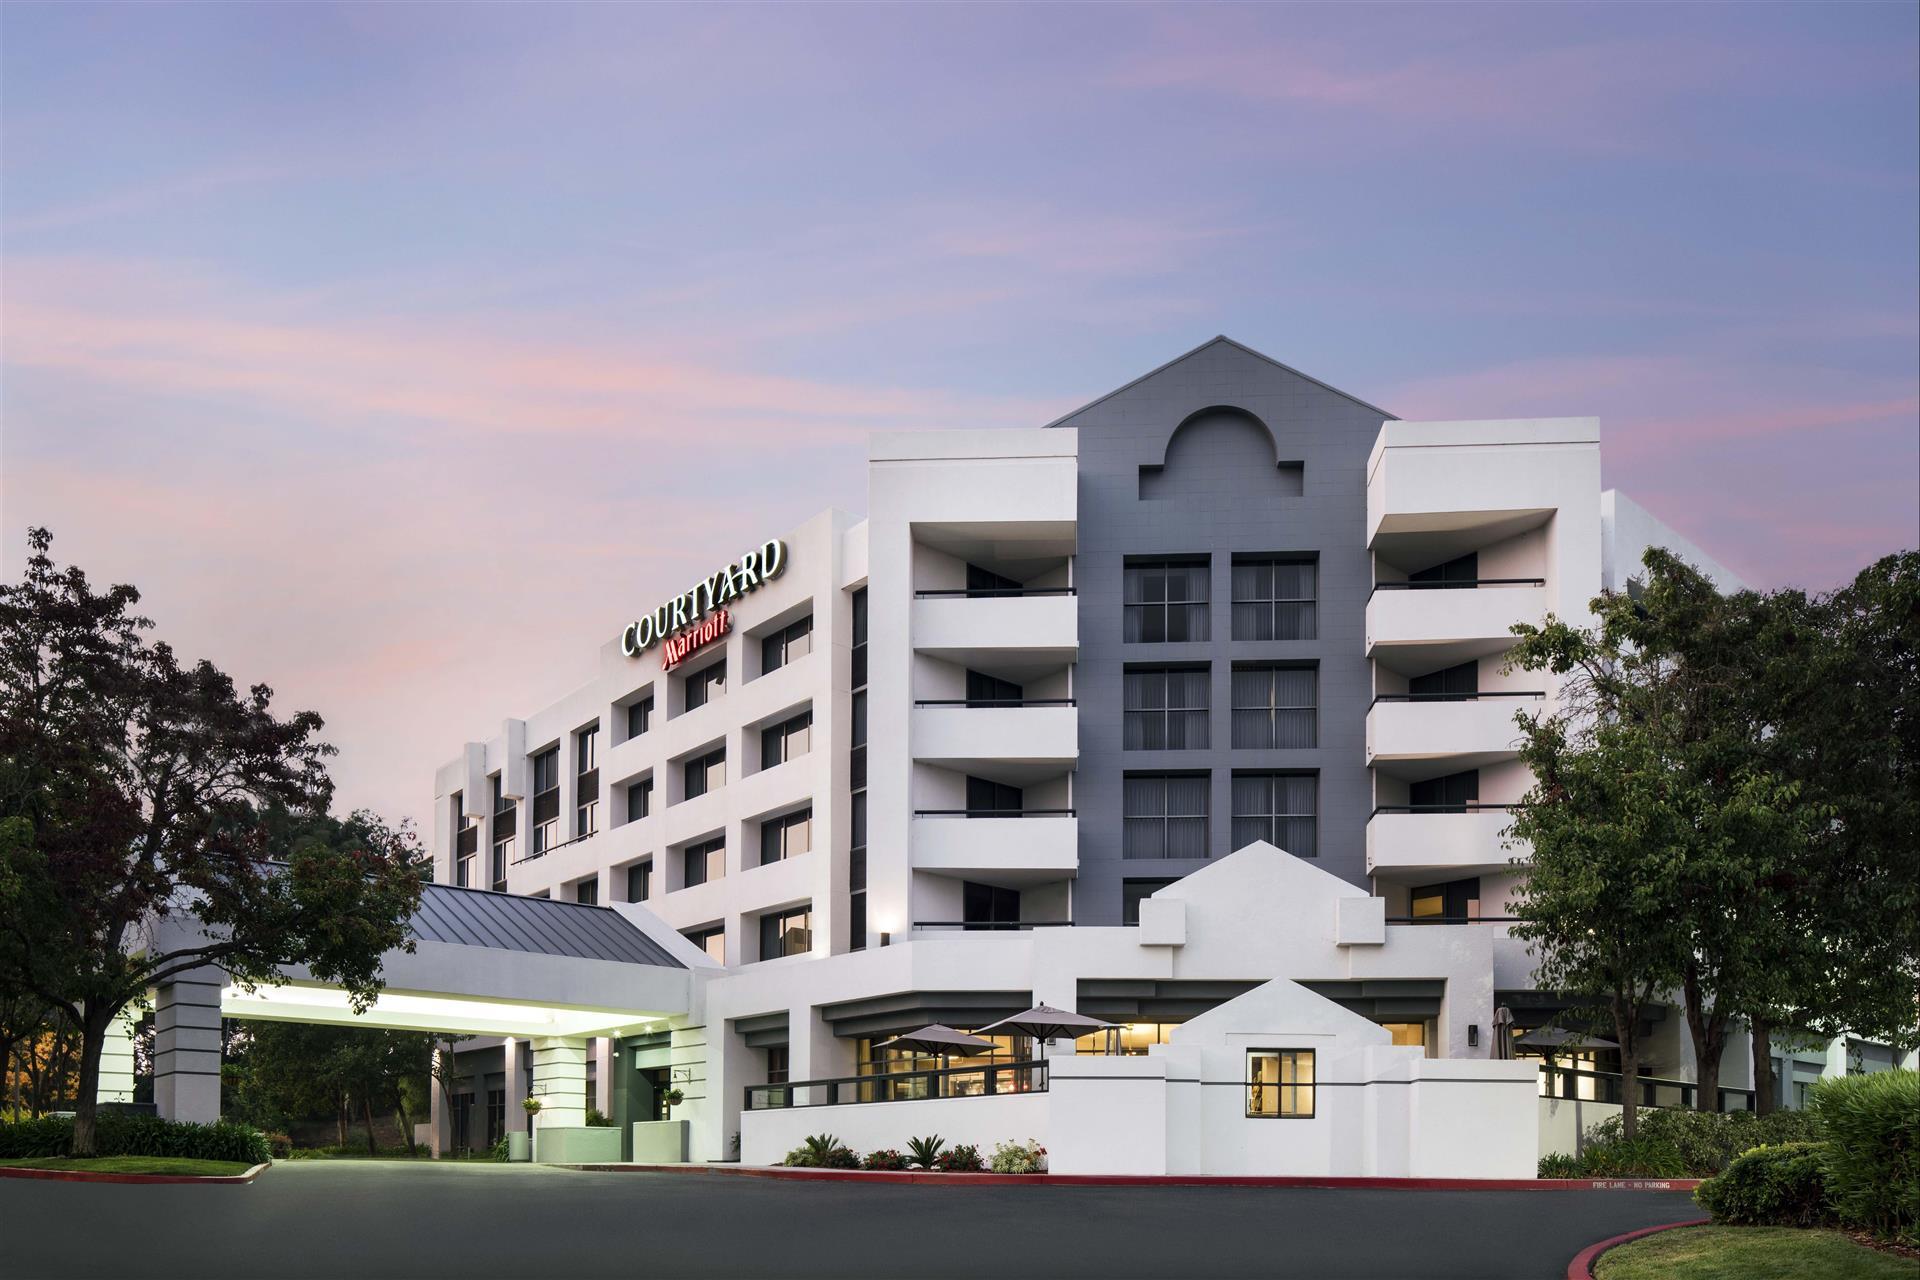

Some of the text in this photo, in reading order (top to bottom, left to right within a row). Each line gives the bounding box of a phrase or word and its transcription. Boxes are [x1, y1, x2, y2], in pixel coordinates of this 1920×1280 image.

[621, 538, 786, 658] COURTYARD
[662, 610, 731, 671] Marriott
[1592, 1181, 1607, 1189] FIRE
[1609, 1181, 1626, 1189] LANE
[1633, 1181, 1643, 1189] NO
[1644, 1181, 1670, 1189] PARKING
